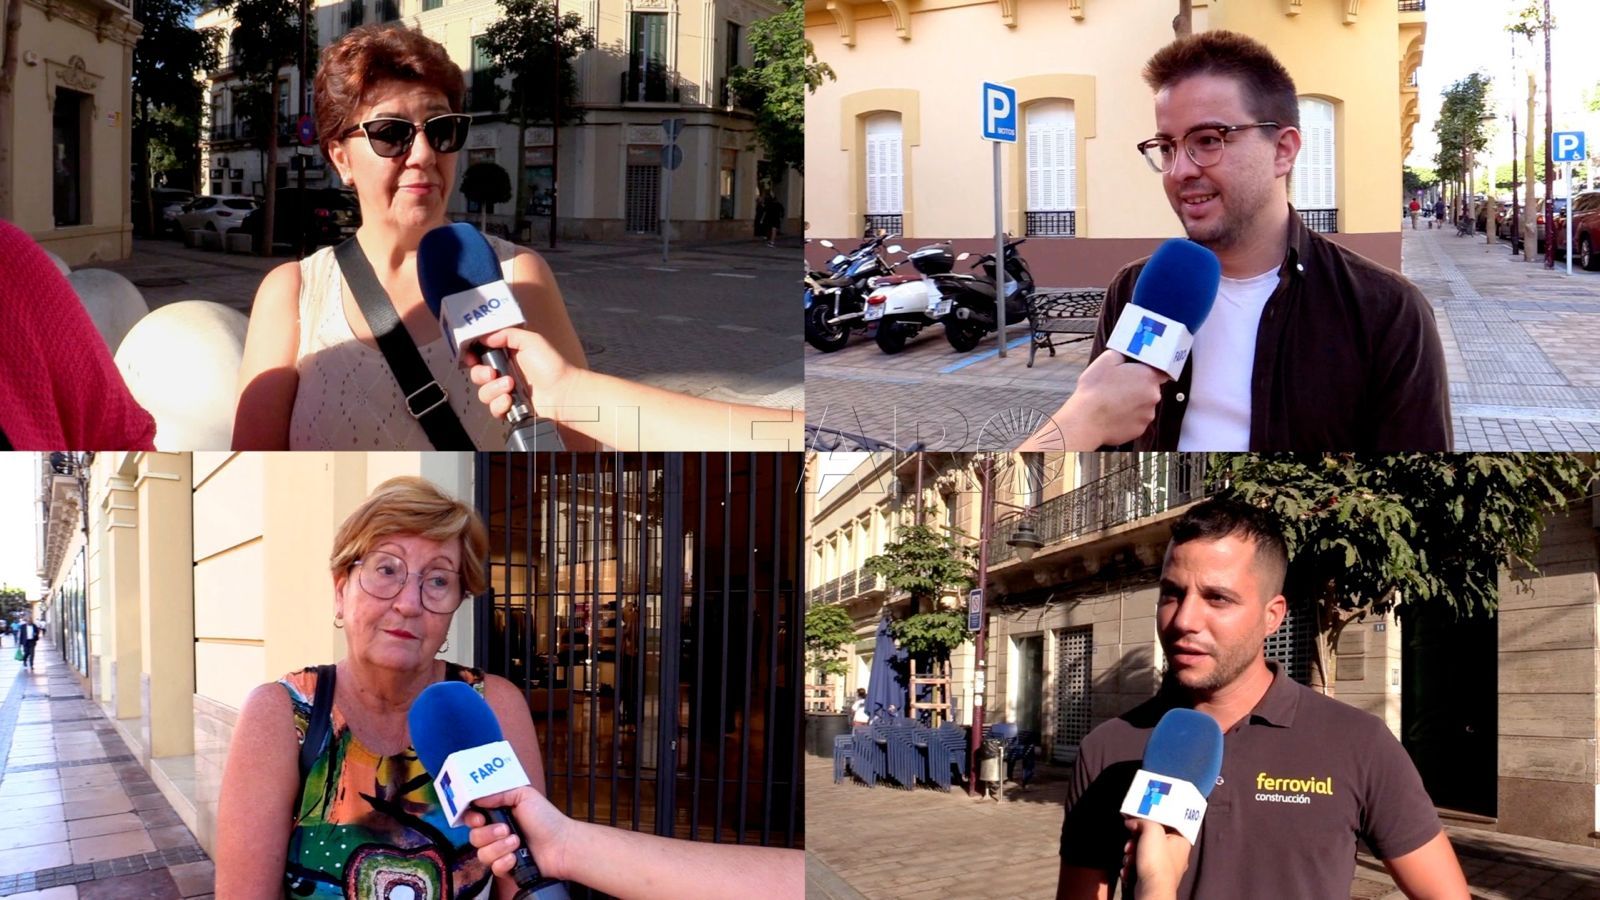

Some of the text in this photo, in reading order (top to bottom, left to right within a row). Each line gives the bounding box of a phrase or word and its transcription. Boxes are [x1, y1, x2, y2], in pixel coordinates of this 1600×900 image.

[987, 88, 1010, 133] P
[1558, 134, 1579, 159] P
[463, 298, 501, 325] FARO
[470, 757, 504, 784] FARO
[1256, 772, 1333, 795] ferrovial
[1255, 793, 1311, 804] construcción
[1184, 808, 1200, 821] FARO
